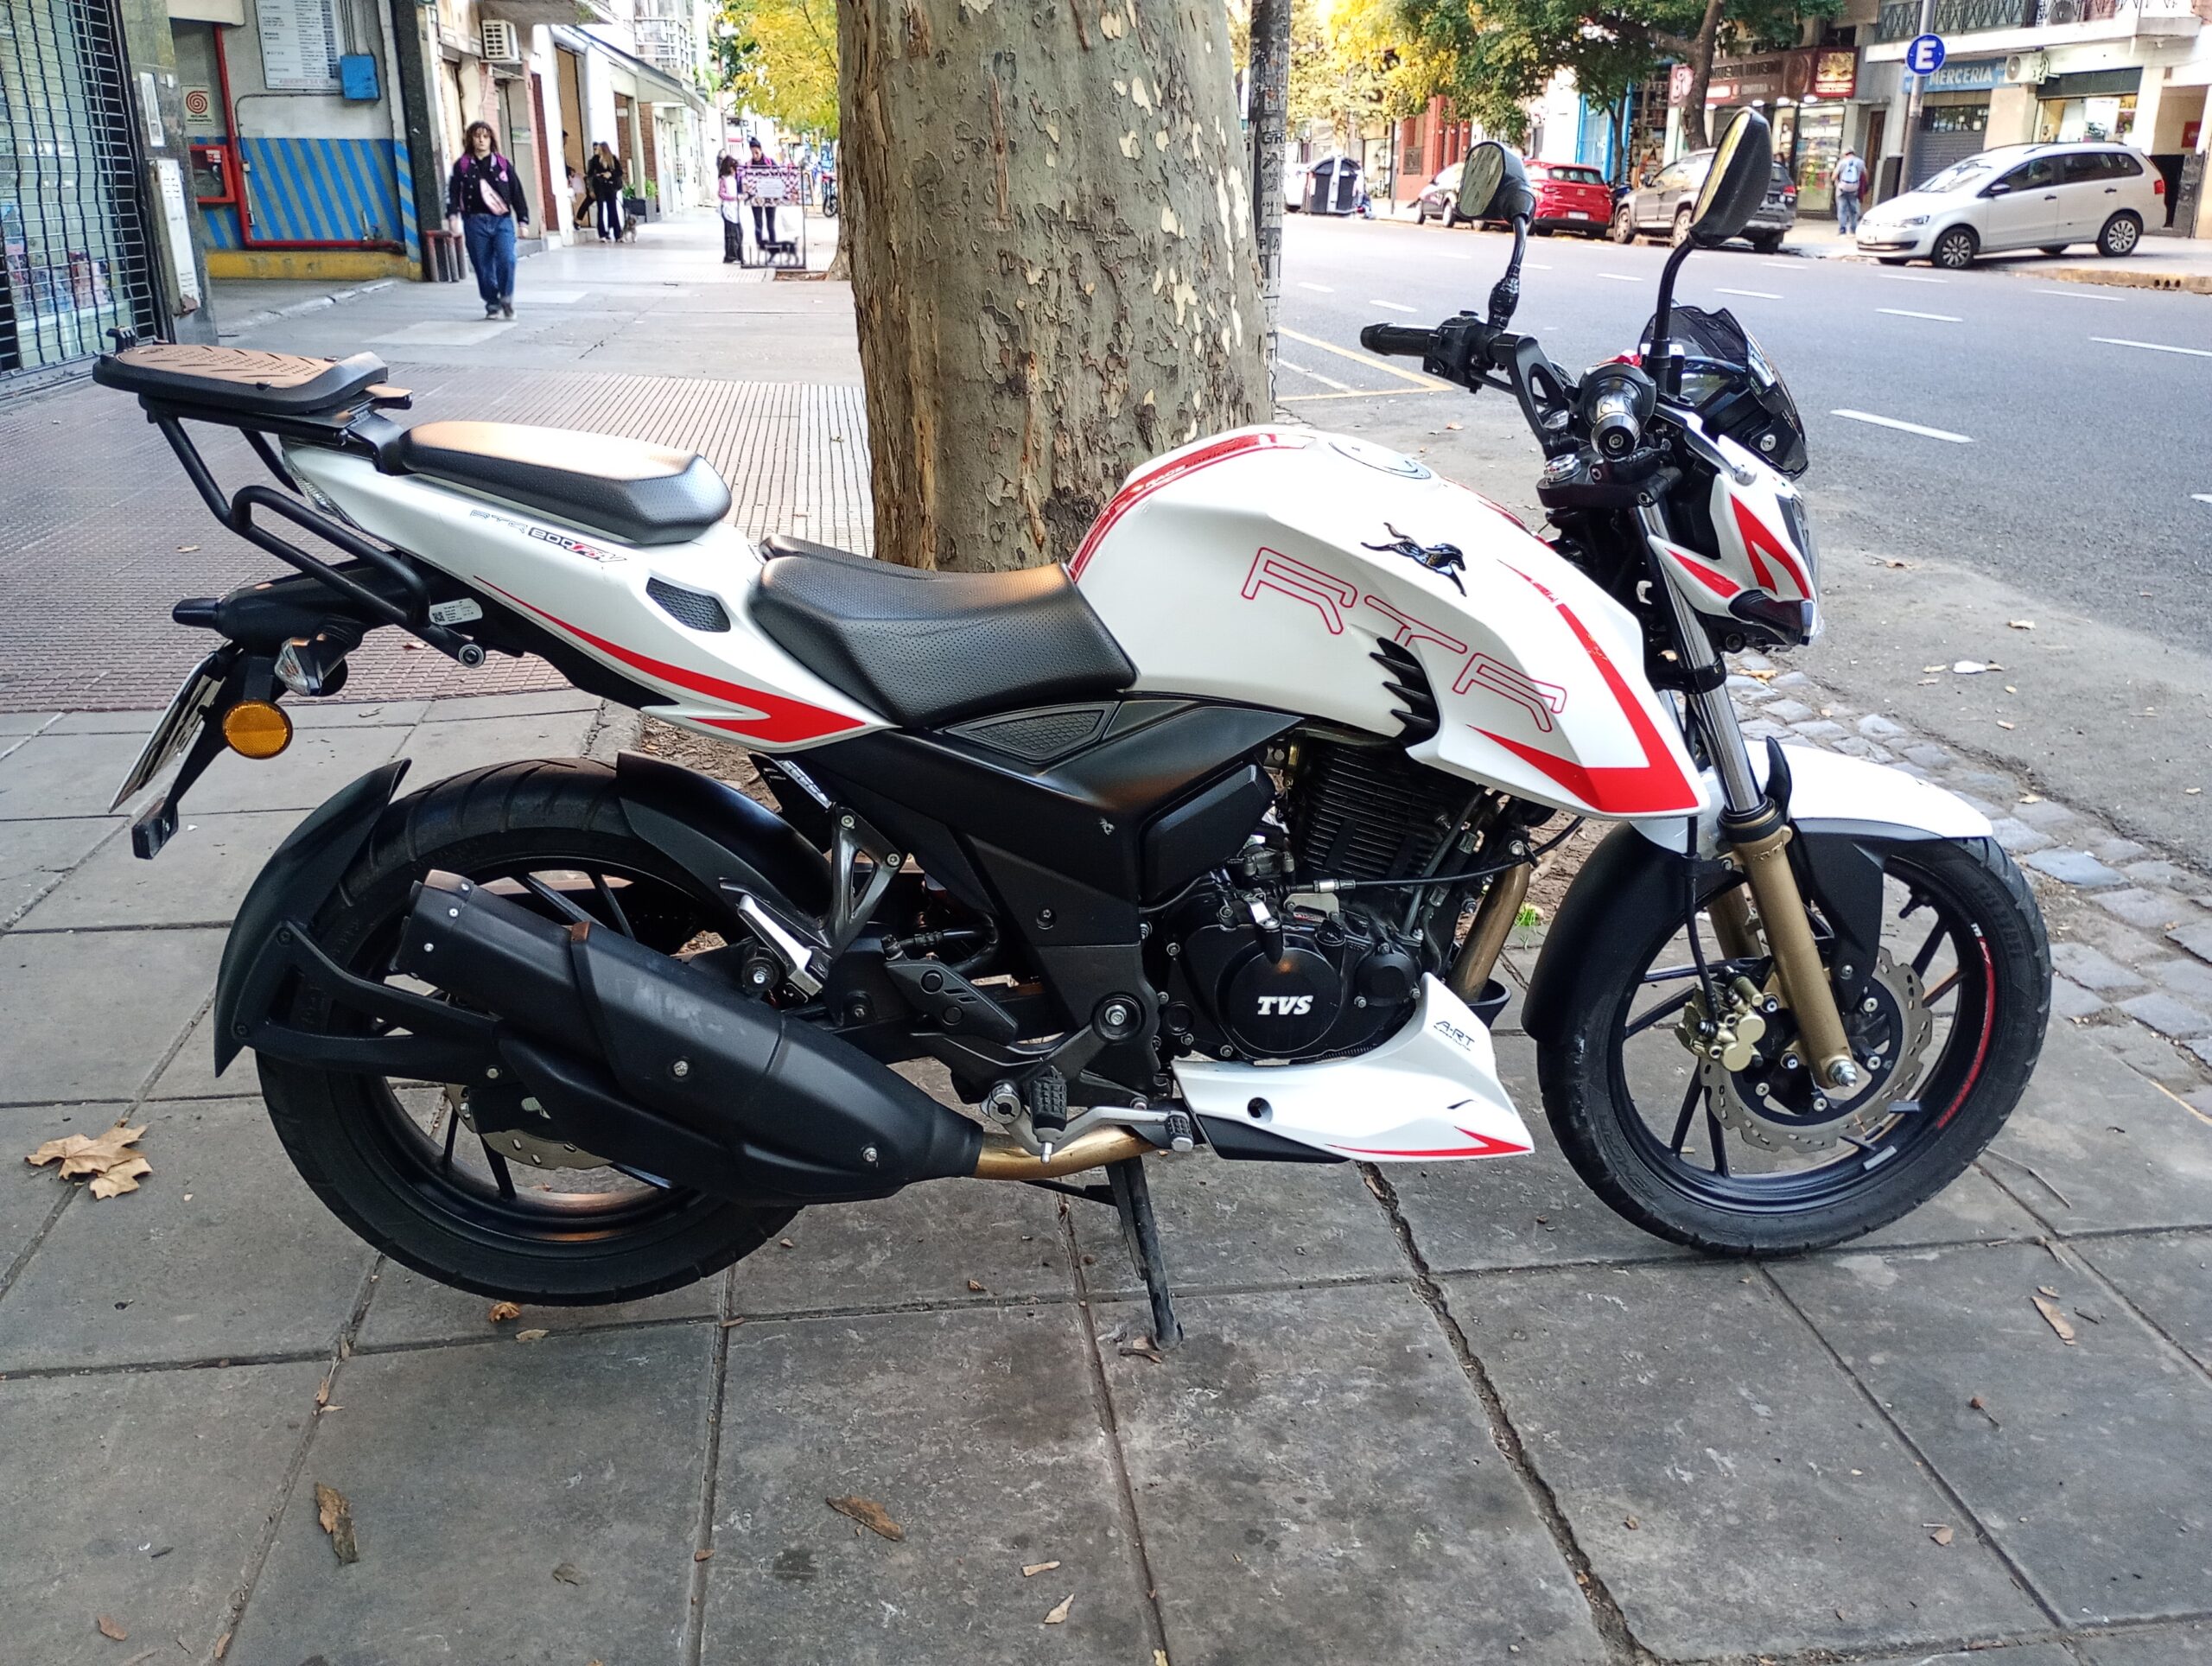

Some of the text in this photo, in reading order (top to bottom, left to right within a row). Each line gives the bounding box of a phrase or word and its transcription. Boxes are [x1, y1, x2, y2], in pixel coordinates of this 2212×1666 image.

[1915, 40, 1936, 69] E
[1929, 67, 1992, 85] MERCERIA
[1241, 547, 1567, 733] RTR
[1257, 995, 1313, 1015] TVS
